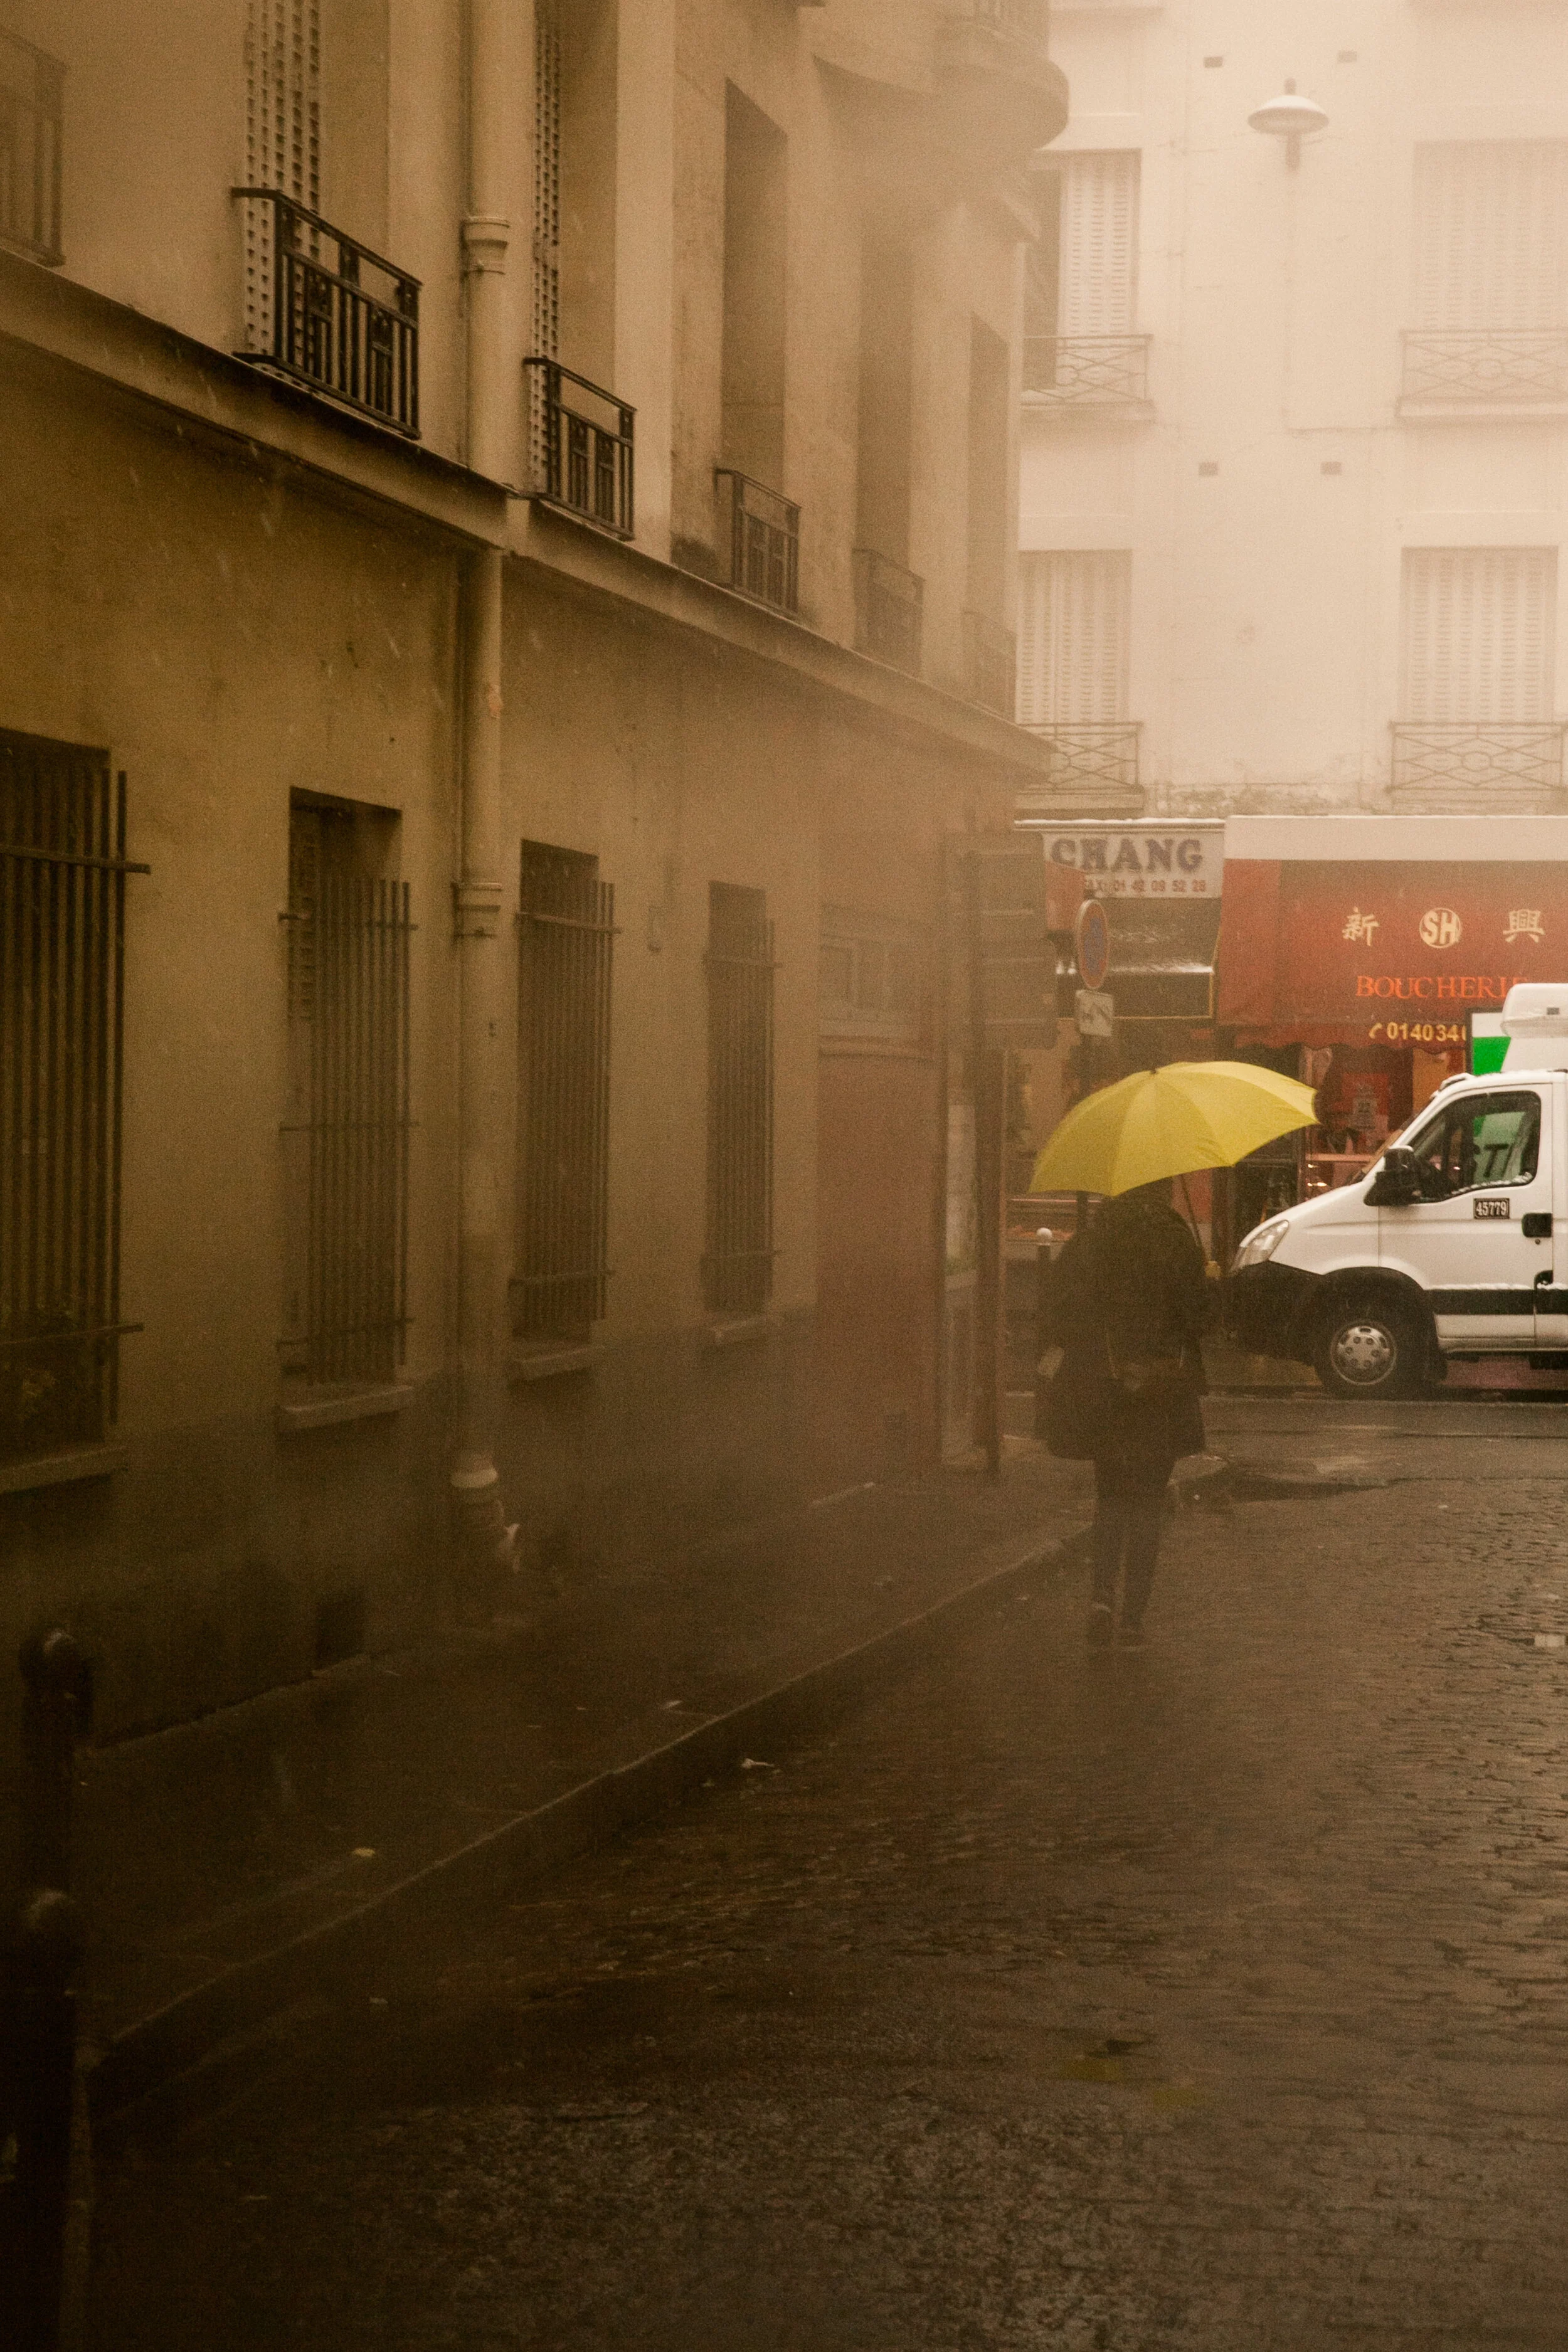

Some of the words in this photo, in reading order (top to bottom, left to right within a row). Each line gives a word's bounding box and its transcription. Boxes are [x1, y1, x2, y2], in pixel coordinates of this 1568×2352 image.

[1051, 838, 1204, 873] CHANG
[1342, 906, 1380, 946] 新
[1421, 908, 1460, 946] SH
[1355, 975, 1528, 999] BOUCHERI
[1476, 1201, 1506, 1216] 45779
